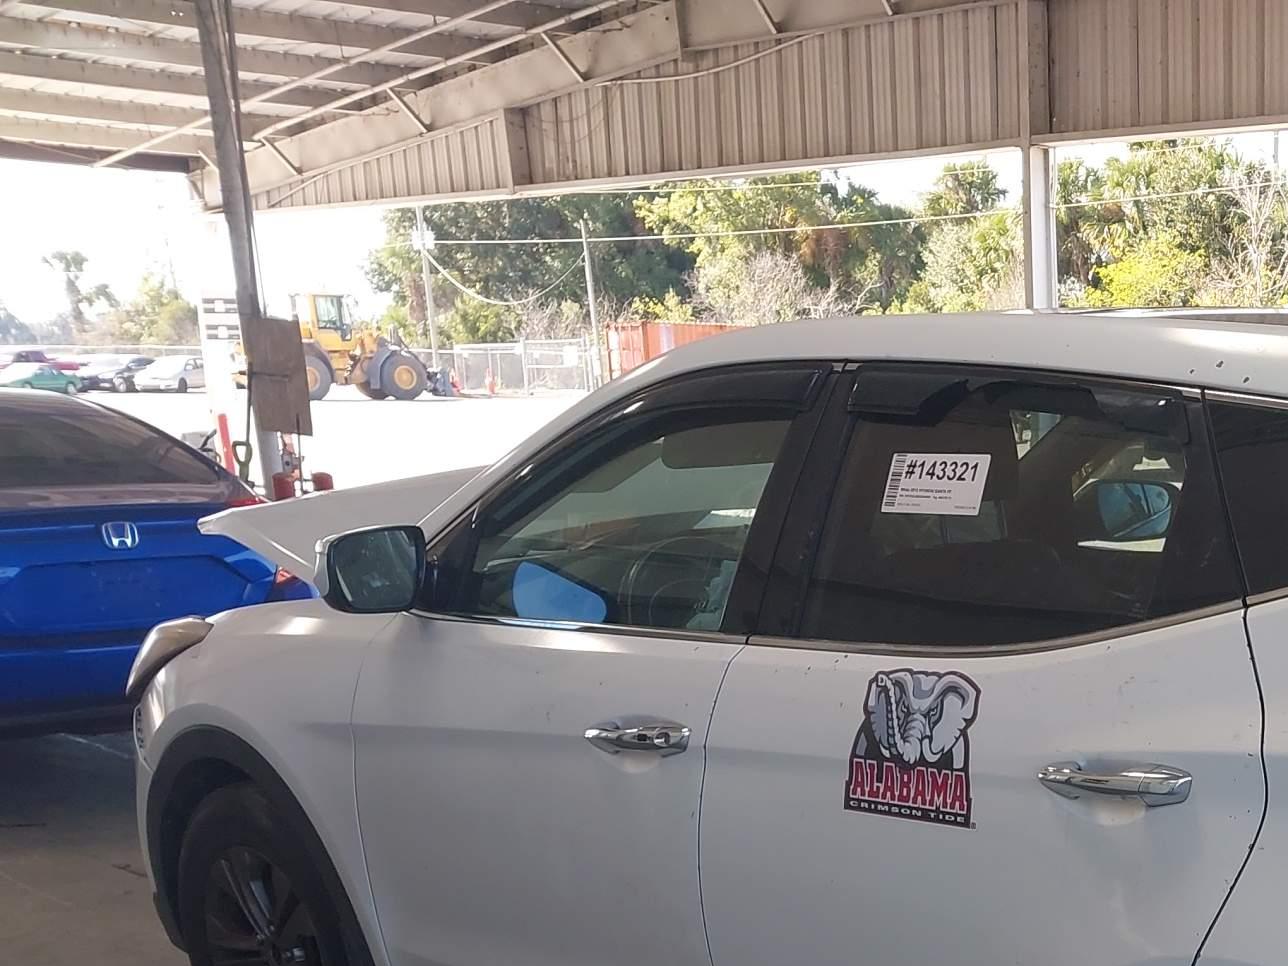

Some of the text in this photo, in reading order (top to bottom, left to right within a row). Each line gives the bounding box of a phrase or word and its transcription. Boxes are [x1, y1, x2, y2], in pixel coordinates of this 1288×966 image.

[904, 459, 979, 482] #143321
[850, 759, 967, 814] ALABAMA
[849, 800, 965, 823] CRIMSON TIDE
